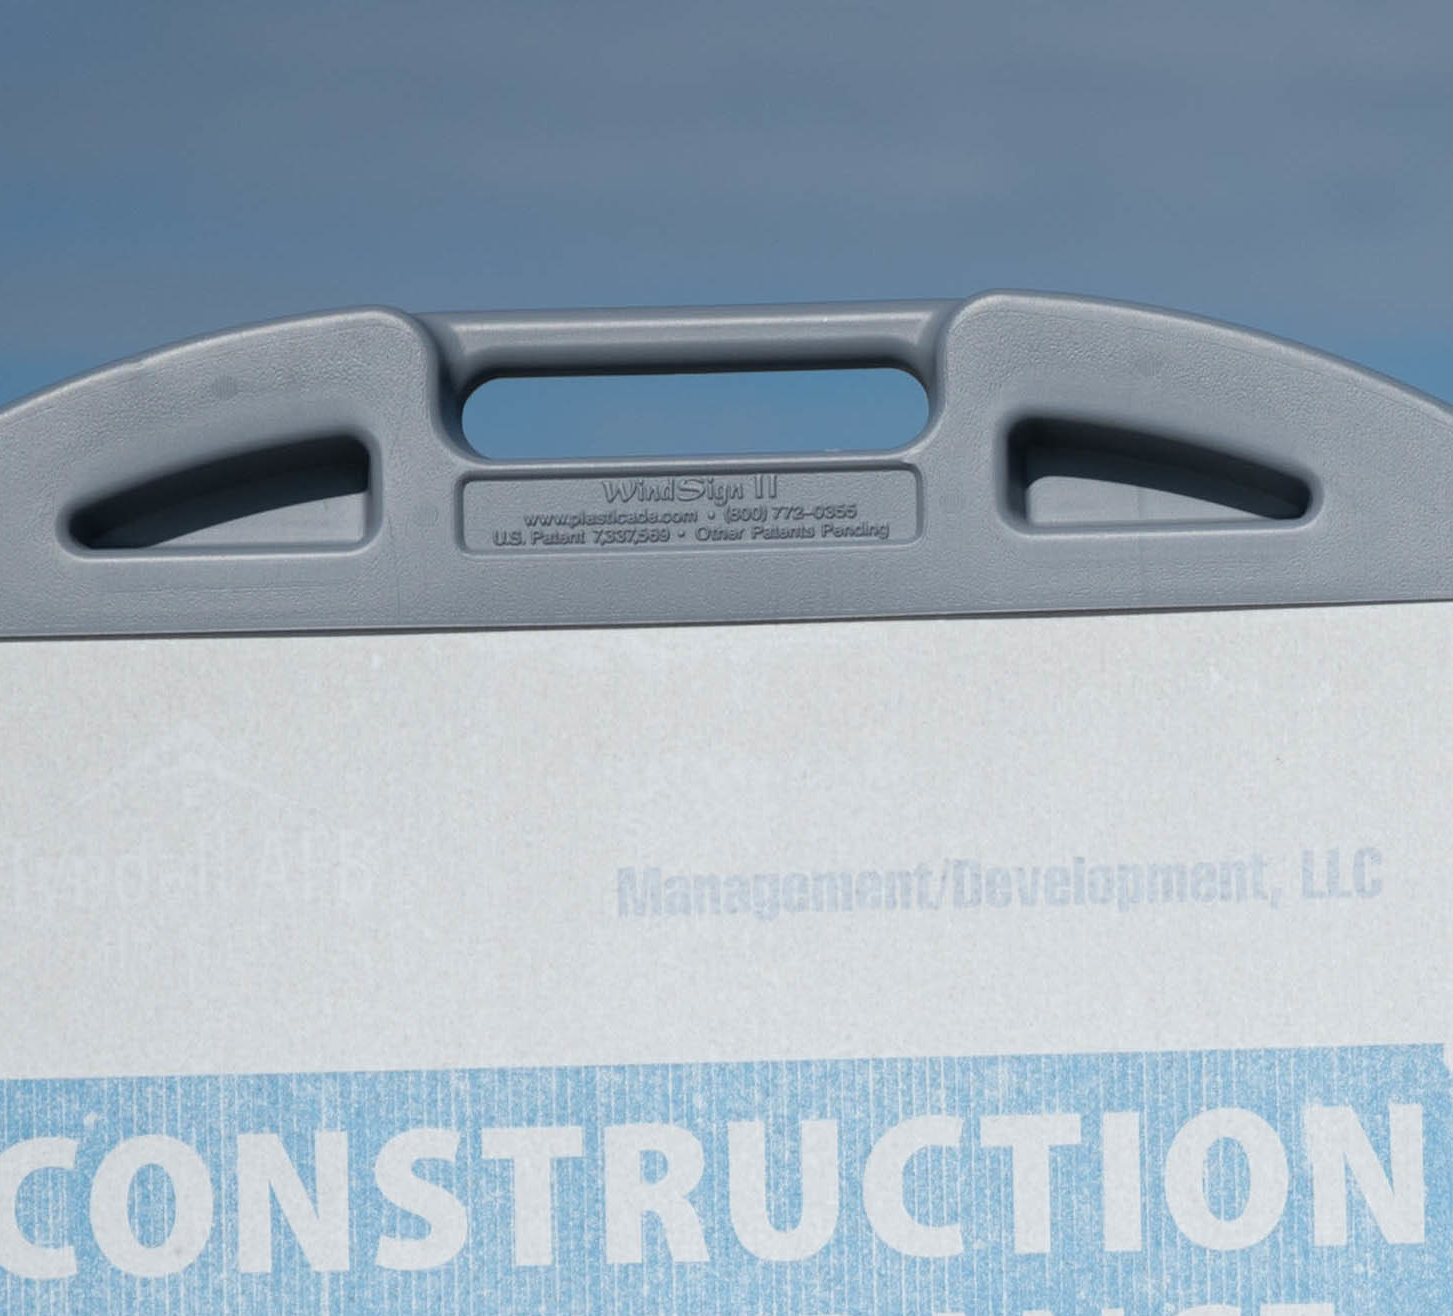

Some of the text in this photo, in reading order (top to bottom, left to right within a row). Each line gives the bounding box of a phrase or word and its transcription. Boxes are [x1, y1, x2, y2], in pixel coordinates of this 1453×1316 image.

[492, 530, 526, 546] U.S.
[530, 528, 587, 545] Patent
[695, 525, 745, 542] Other
[751, 523, 816, 540] Patents
[821, 520, 890, 540] Pending
[616, 846, 1382, 920] Management/Development, LLC
